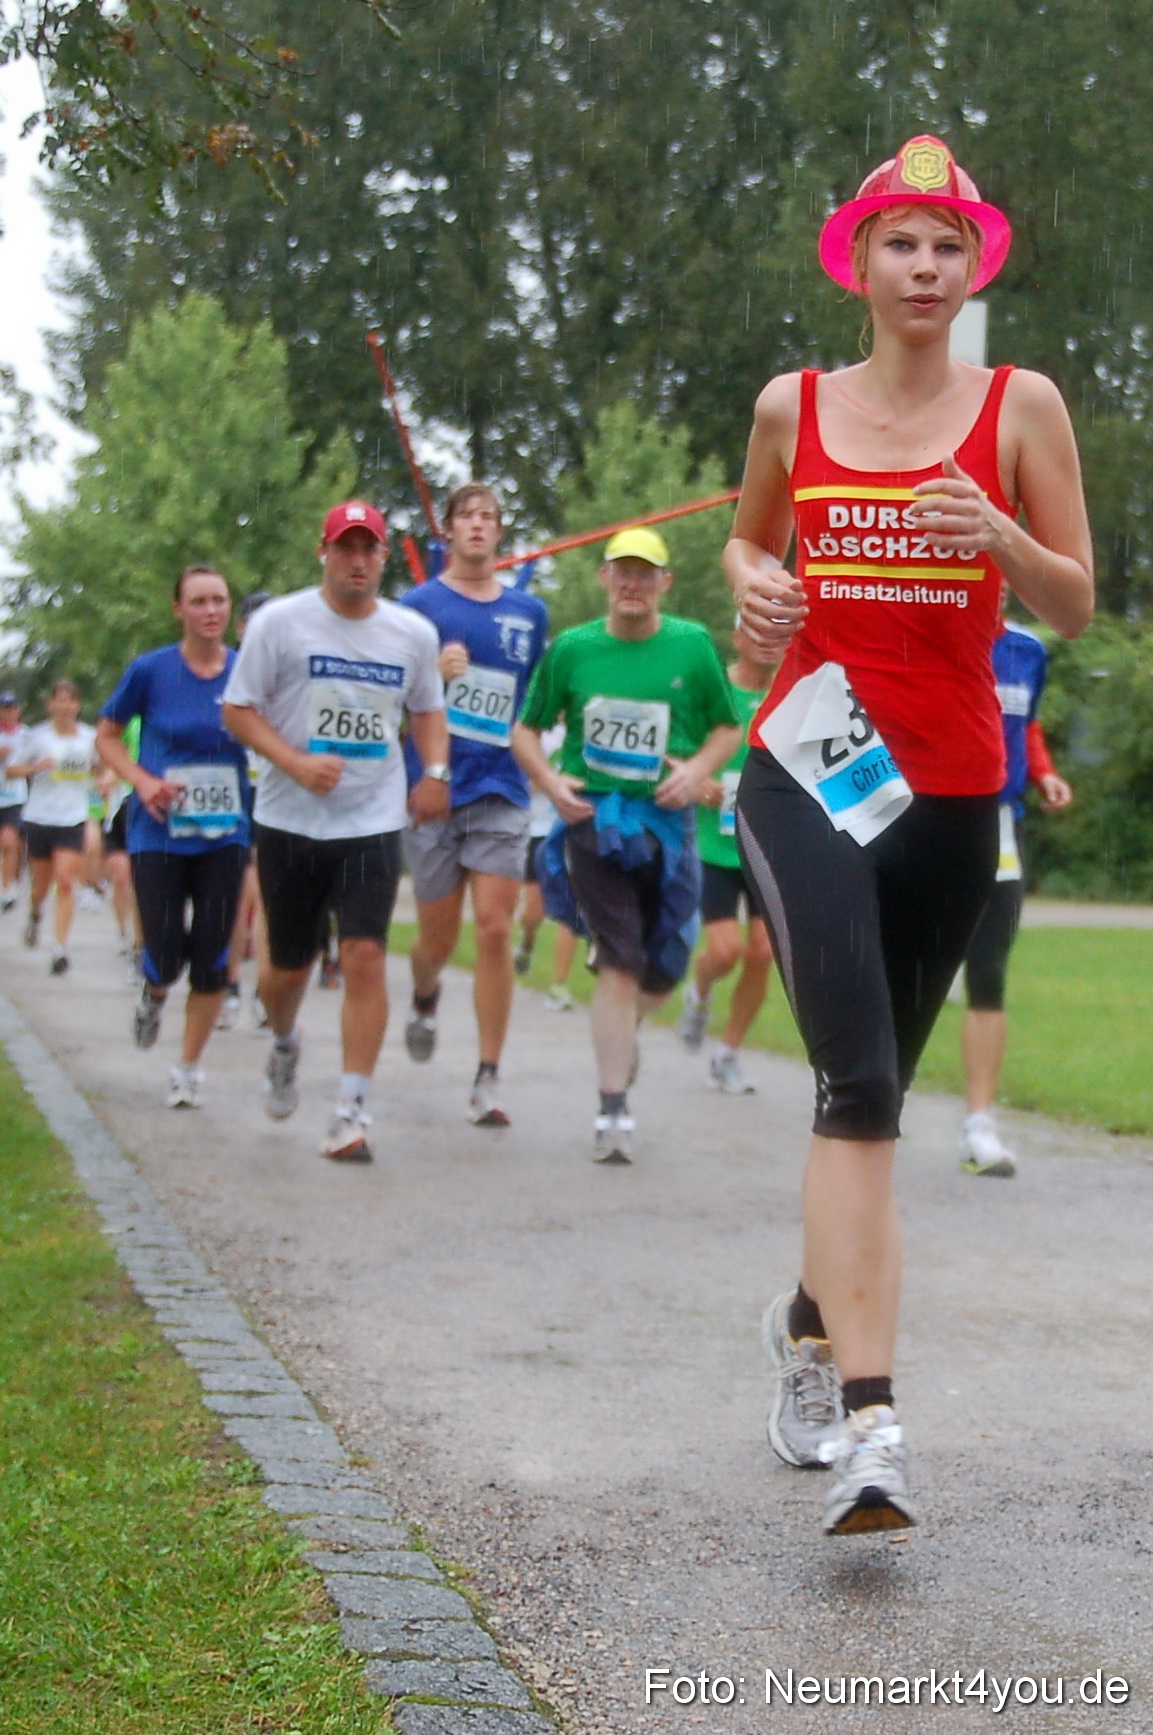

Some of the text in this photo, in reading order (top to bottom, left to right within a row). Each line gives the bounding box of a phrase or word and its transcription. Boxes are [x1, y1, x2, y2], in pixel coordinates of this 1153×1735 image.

[820, 581, 968, 608] Einsatzleitung
[454, 683, 511, 718] 2607
[590, 718, 657, 752] 2764
